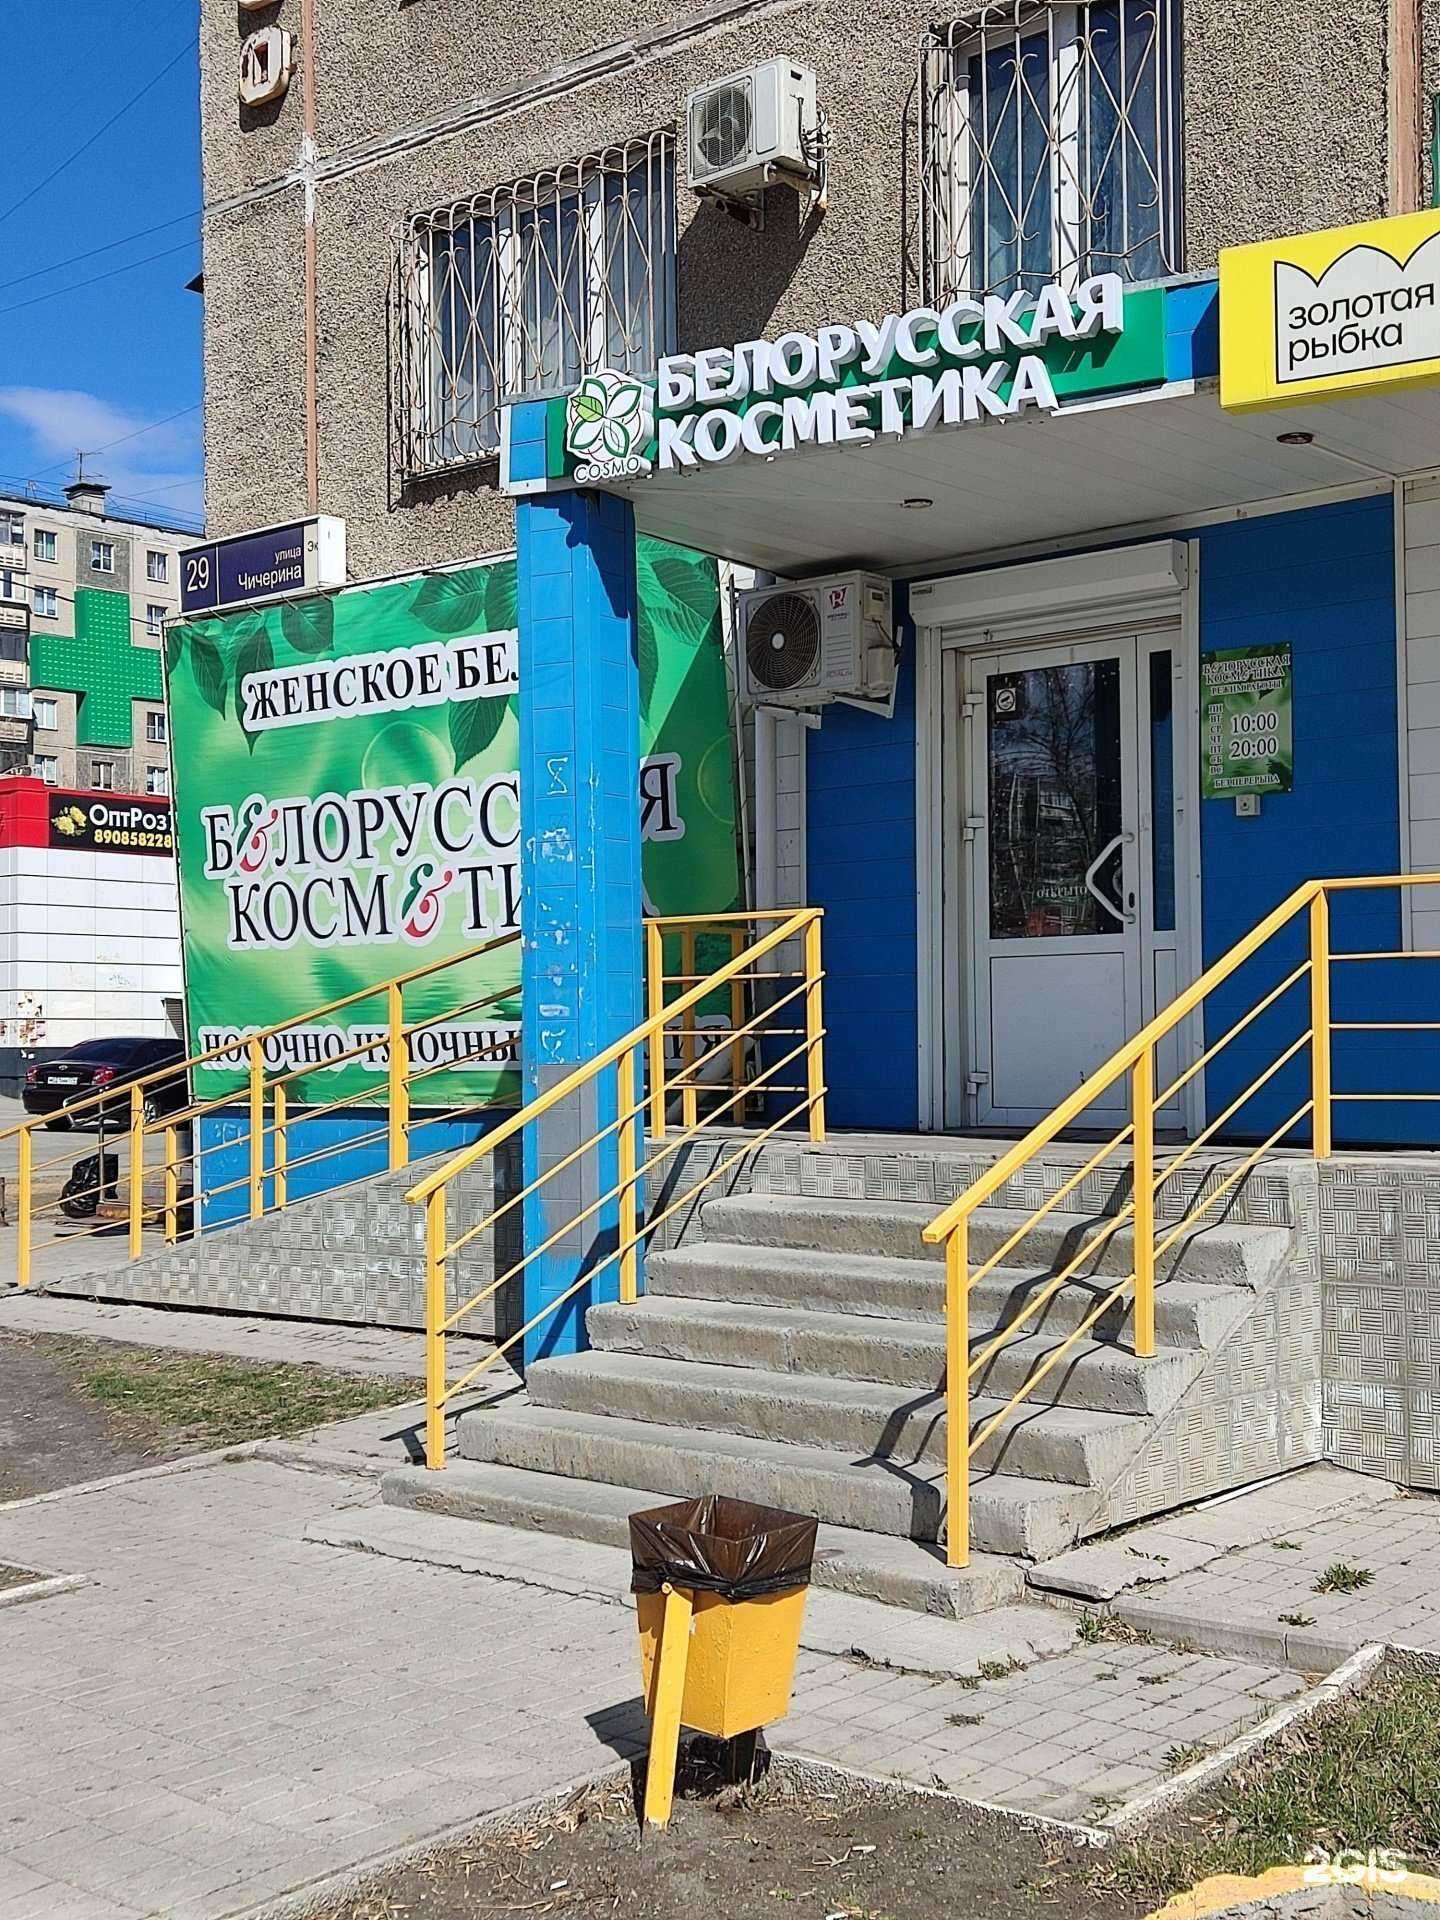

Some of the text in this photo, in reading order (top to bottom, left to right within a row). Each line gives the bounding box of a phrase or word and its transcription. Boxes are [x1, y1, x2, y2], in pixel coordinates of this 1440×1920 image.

[1288, 283, 1435, 330] золотая
[658, 273, 1124, 410] БЕЛОРУССКАЯ
[1289, 322, 1403, 371] рыбка
[658, 355, 1059, 469] КОСМЕТИКА
[575, 456, 640, 481] COSMO
[274, 546, 302, 565] улица
[186, 556, 210, 593] 29
[238, 564, 302, 591] Чичерина
[247, 642, 520, 721] ЖЕНСКОЕ БЕ
[1231, 712, 1277, 734] 10:00
[1230, 737, 1277, 758] 20:00
[88, 803, 174, 832] ОптРоз
